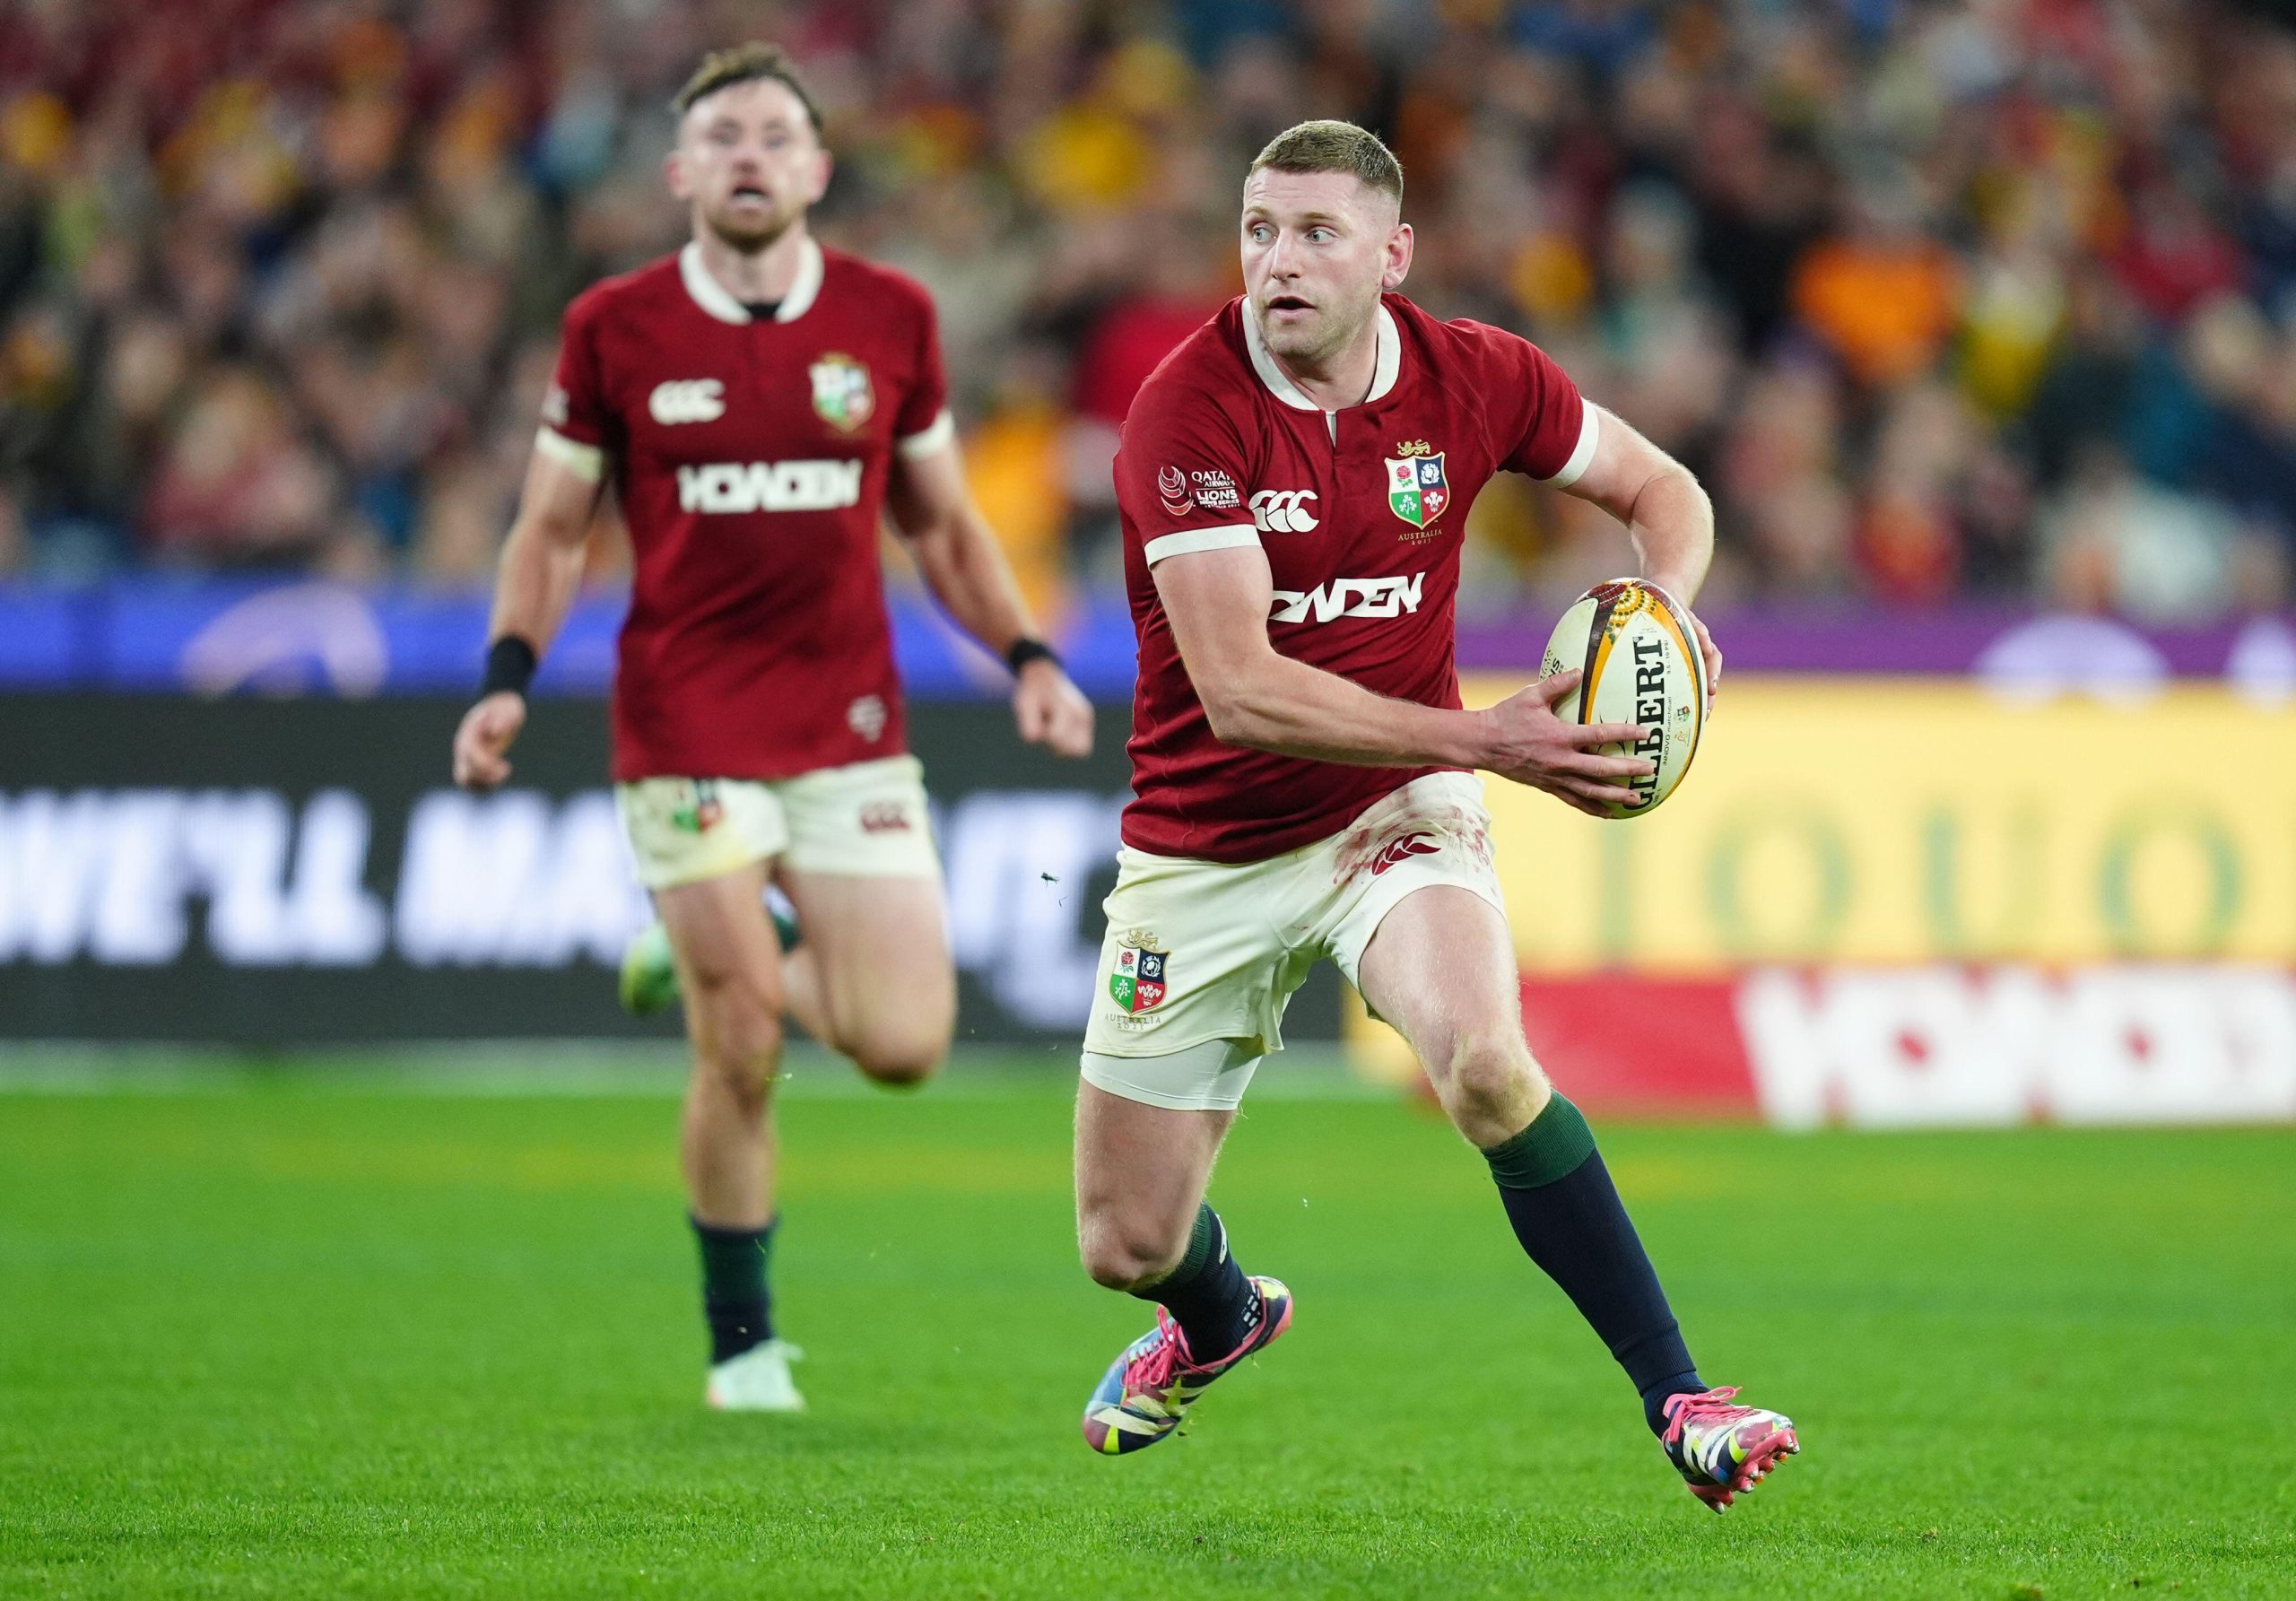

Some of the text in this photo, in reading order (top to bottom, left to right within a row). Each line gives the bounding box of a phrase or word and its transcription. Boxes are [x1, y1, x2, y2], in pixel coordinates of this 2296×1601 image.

[1196, 489, 1238, 500] LIONS
[1397, 529, 1442, 542] AUSTRALIA
[1104, 1014, 1161, 1024] AUSTRALIA
